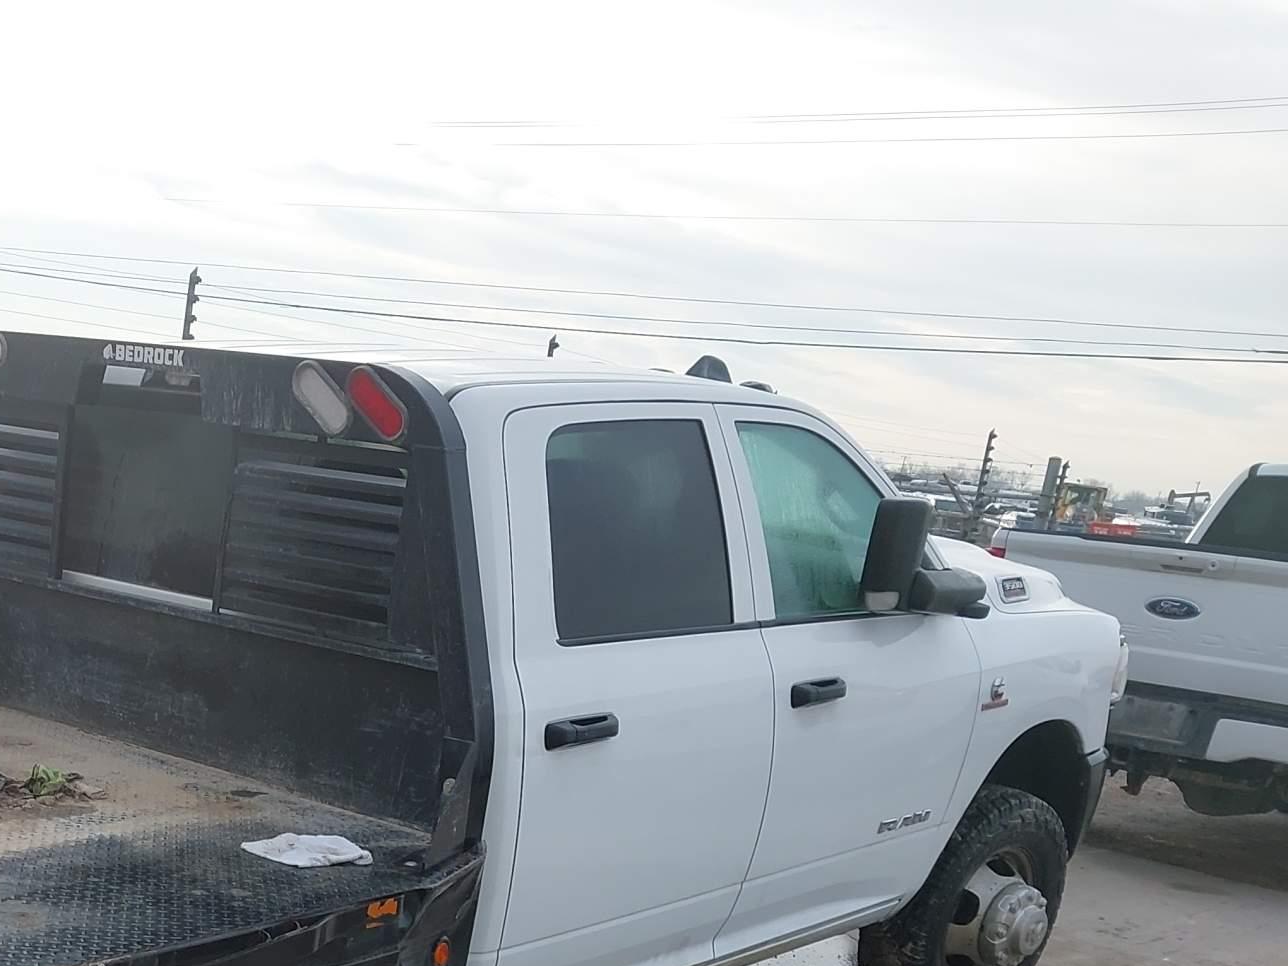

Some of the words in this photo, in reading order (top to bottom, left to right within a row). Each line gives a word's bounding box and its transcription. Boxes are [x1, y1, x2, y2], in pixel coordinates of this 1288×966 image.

[115, 344, 184, 367] BEDROCK
[1155, 600, 1189, 616] Ford
[877, 809, 932, 834] RAM
